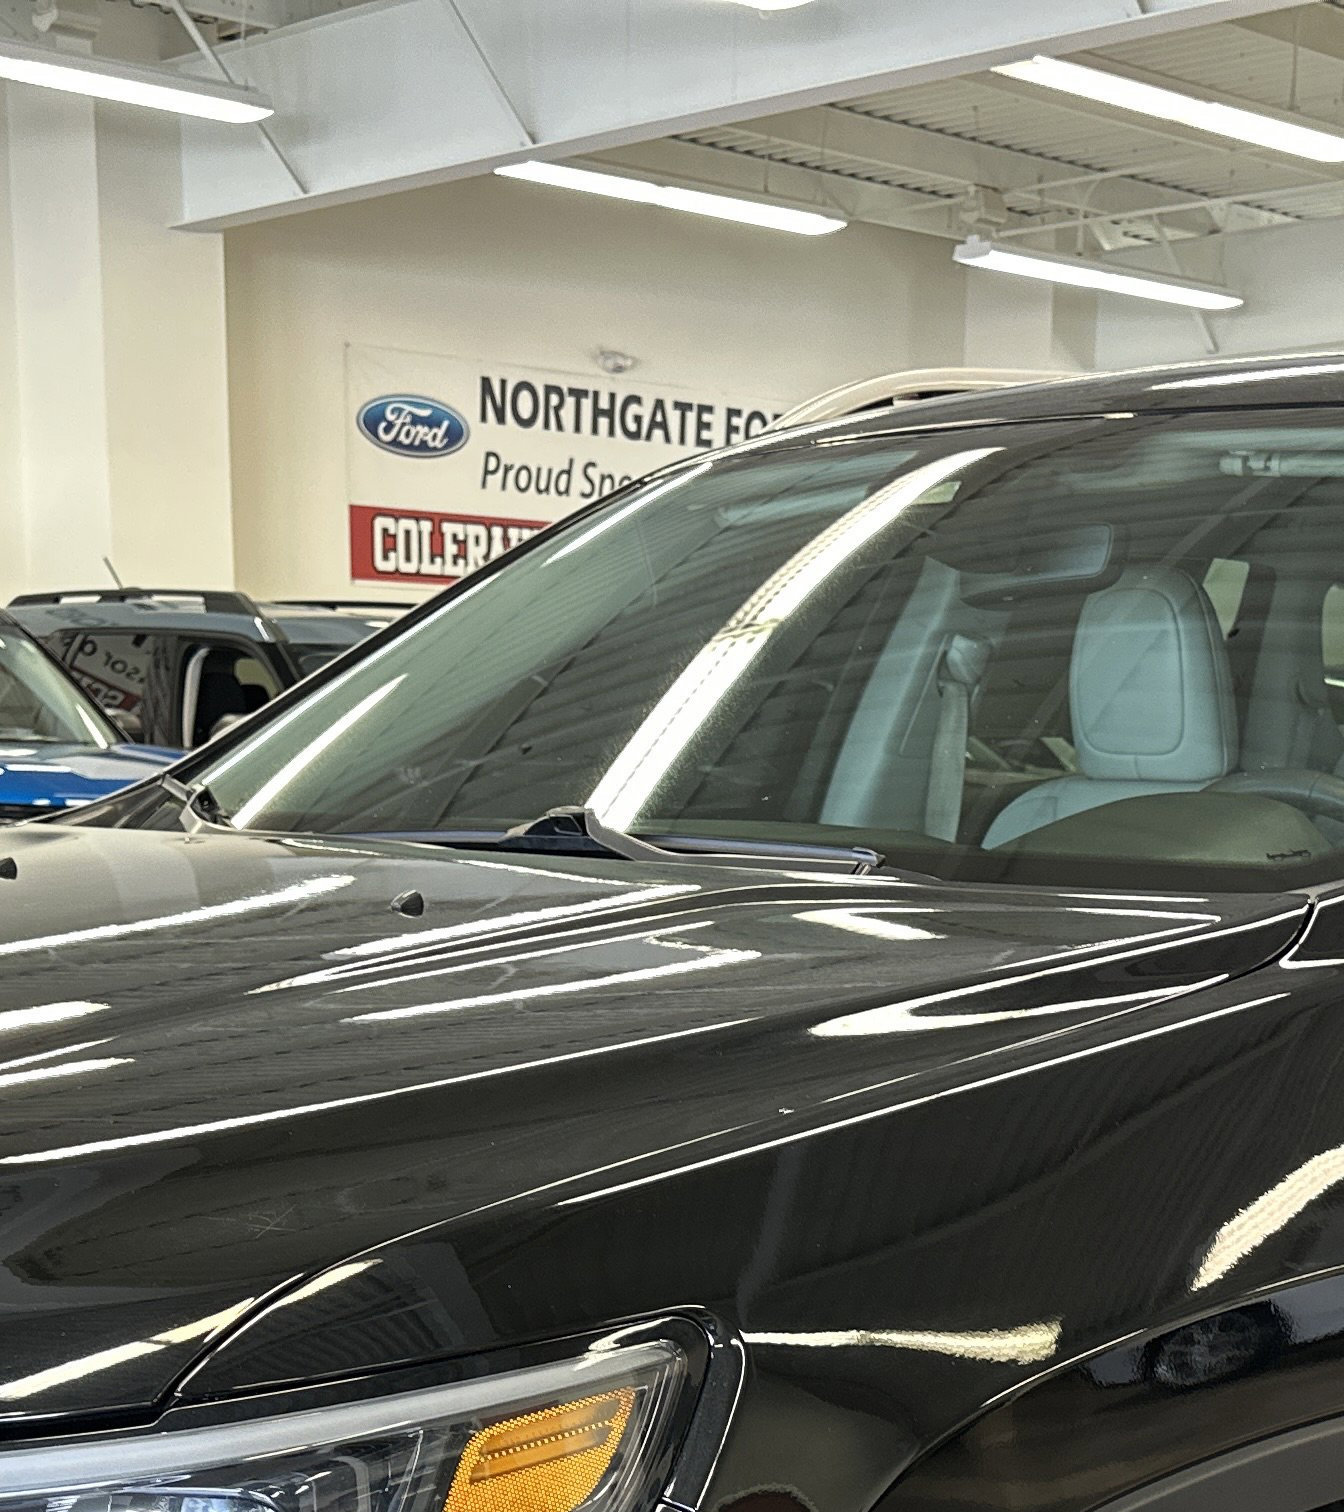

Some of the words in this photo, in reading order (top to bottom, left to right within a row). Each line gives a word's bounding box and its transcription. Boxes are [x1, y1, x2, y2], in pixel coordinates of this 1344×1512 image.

[376, 401, 450, 451] Ford
[479, 375, 714, 449] NORTHGATE
[725, 408, 784, 448] FO
[481, 451, 574, 498] Proud
